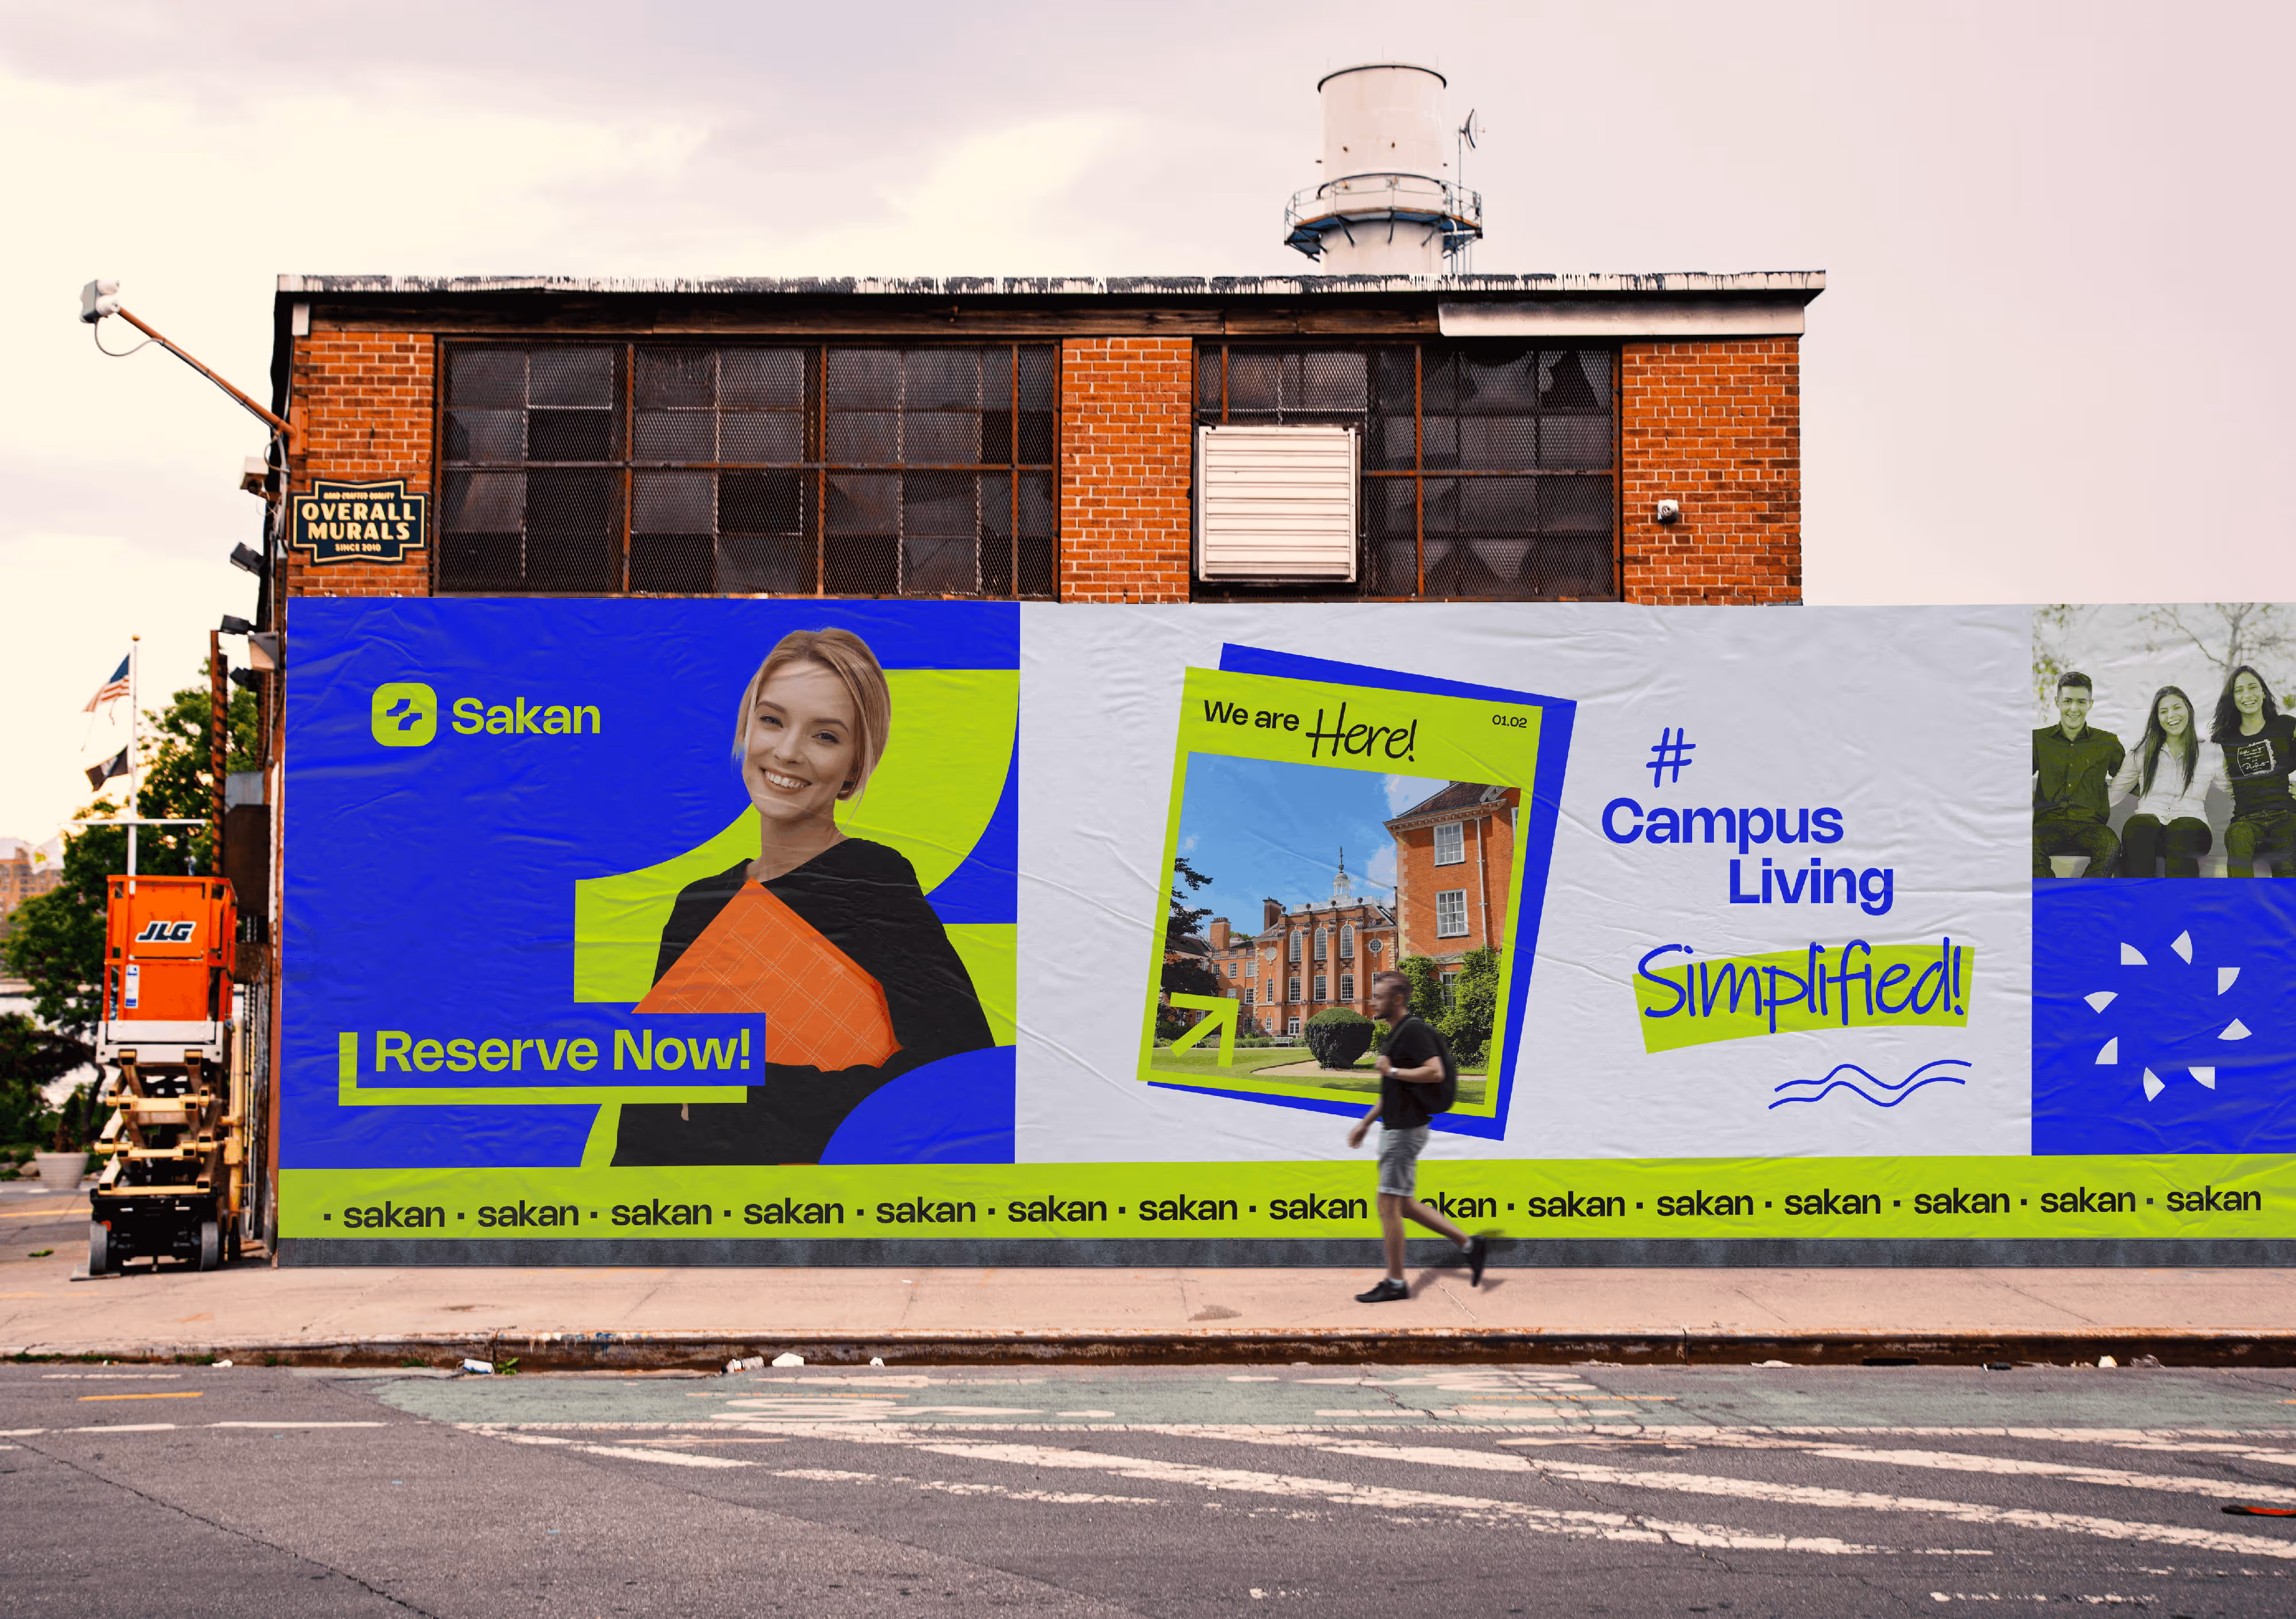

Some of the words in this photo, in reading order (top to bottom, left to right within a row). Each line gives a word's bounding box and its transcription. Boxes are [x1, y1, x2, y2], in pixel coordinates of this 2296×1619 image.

[301, 502, 416, 521] OVERALL
[308, 522, 410, 540] MURALS
[335, 544, 360, 552] SINCE
[361, 544, 381, 552] 2010
[452, 696, 600, 735] Sakan
[1204, 700, 1248, 726] We
[1254, 711, 1300, 731] are
[1305, 702, 1417, 762] Here!
[1492, 714, 1527, 729] 01.02
[1646, 727, 1696, 788] #
[1601, 797, 1844, 855] Campus
[1729, 857, 1894, 916] Living
[136, 921, 196, 942] JLG
[1638, 936, 1964, 1034] Simplified!
[375, 1030, 599, 1072] Reserve
[614, 1028, 750, 1071] Now!
[344, 1201, 444, 1228] sakan
[478, 1200, 579, 1227] sakan
[612, 1199, 711, 1225] sakan
[744, 1198, 843, 1224] sakan
[876, 1197, 975, 1223] sakan
[1009, 1195, 1106, 1222] sakan
[1139, 1194, 1237, 1221] sakan
[1270, 1194, 1367, 1219] sakan
[1401, 1192, 1496, 1218] kan
[1529, 1191, 1624, 1217] sakan
[1657, 1190, 1753, 1216] sakan
[1785, 1189, 1880, 1215] sakan
[1914, 1188, 2010, 1214] sakan
[2041, 1187, 2135, 1213] sakan
[2167, 1186, 2260, 1211] sakan
